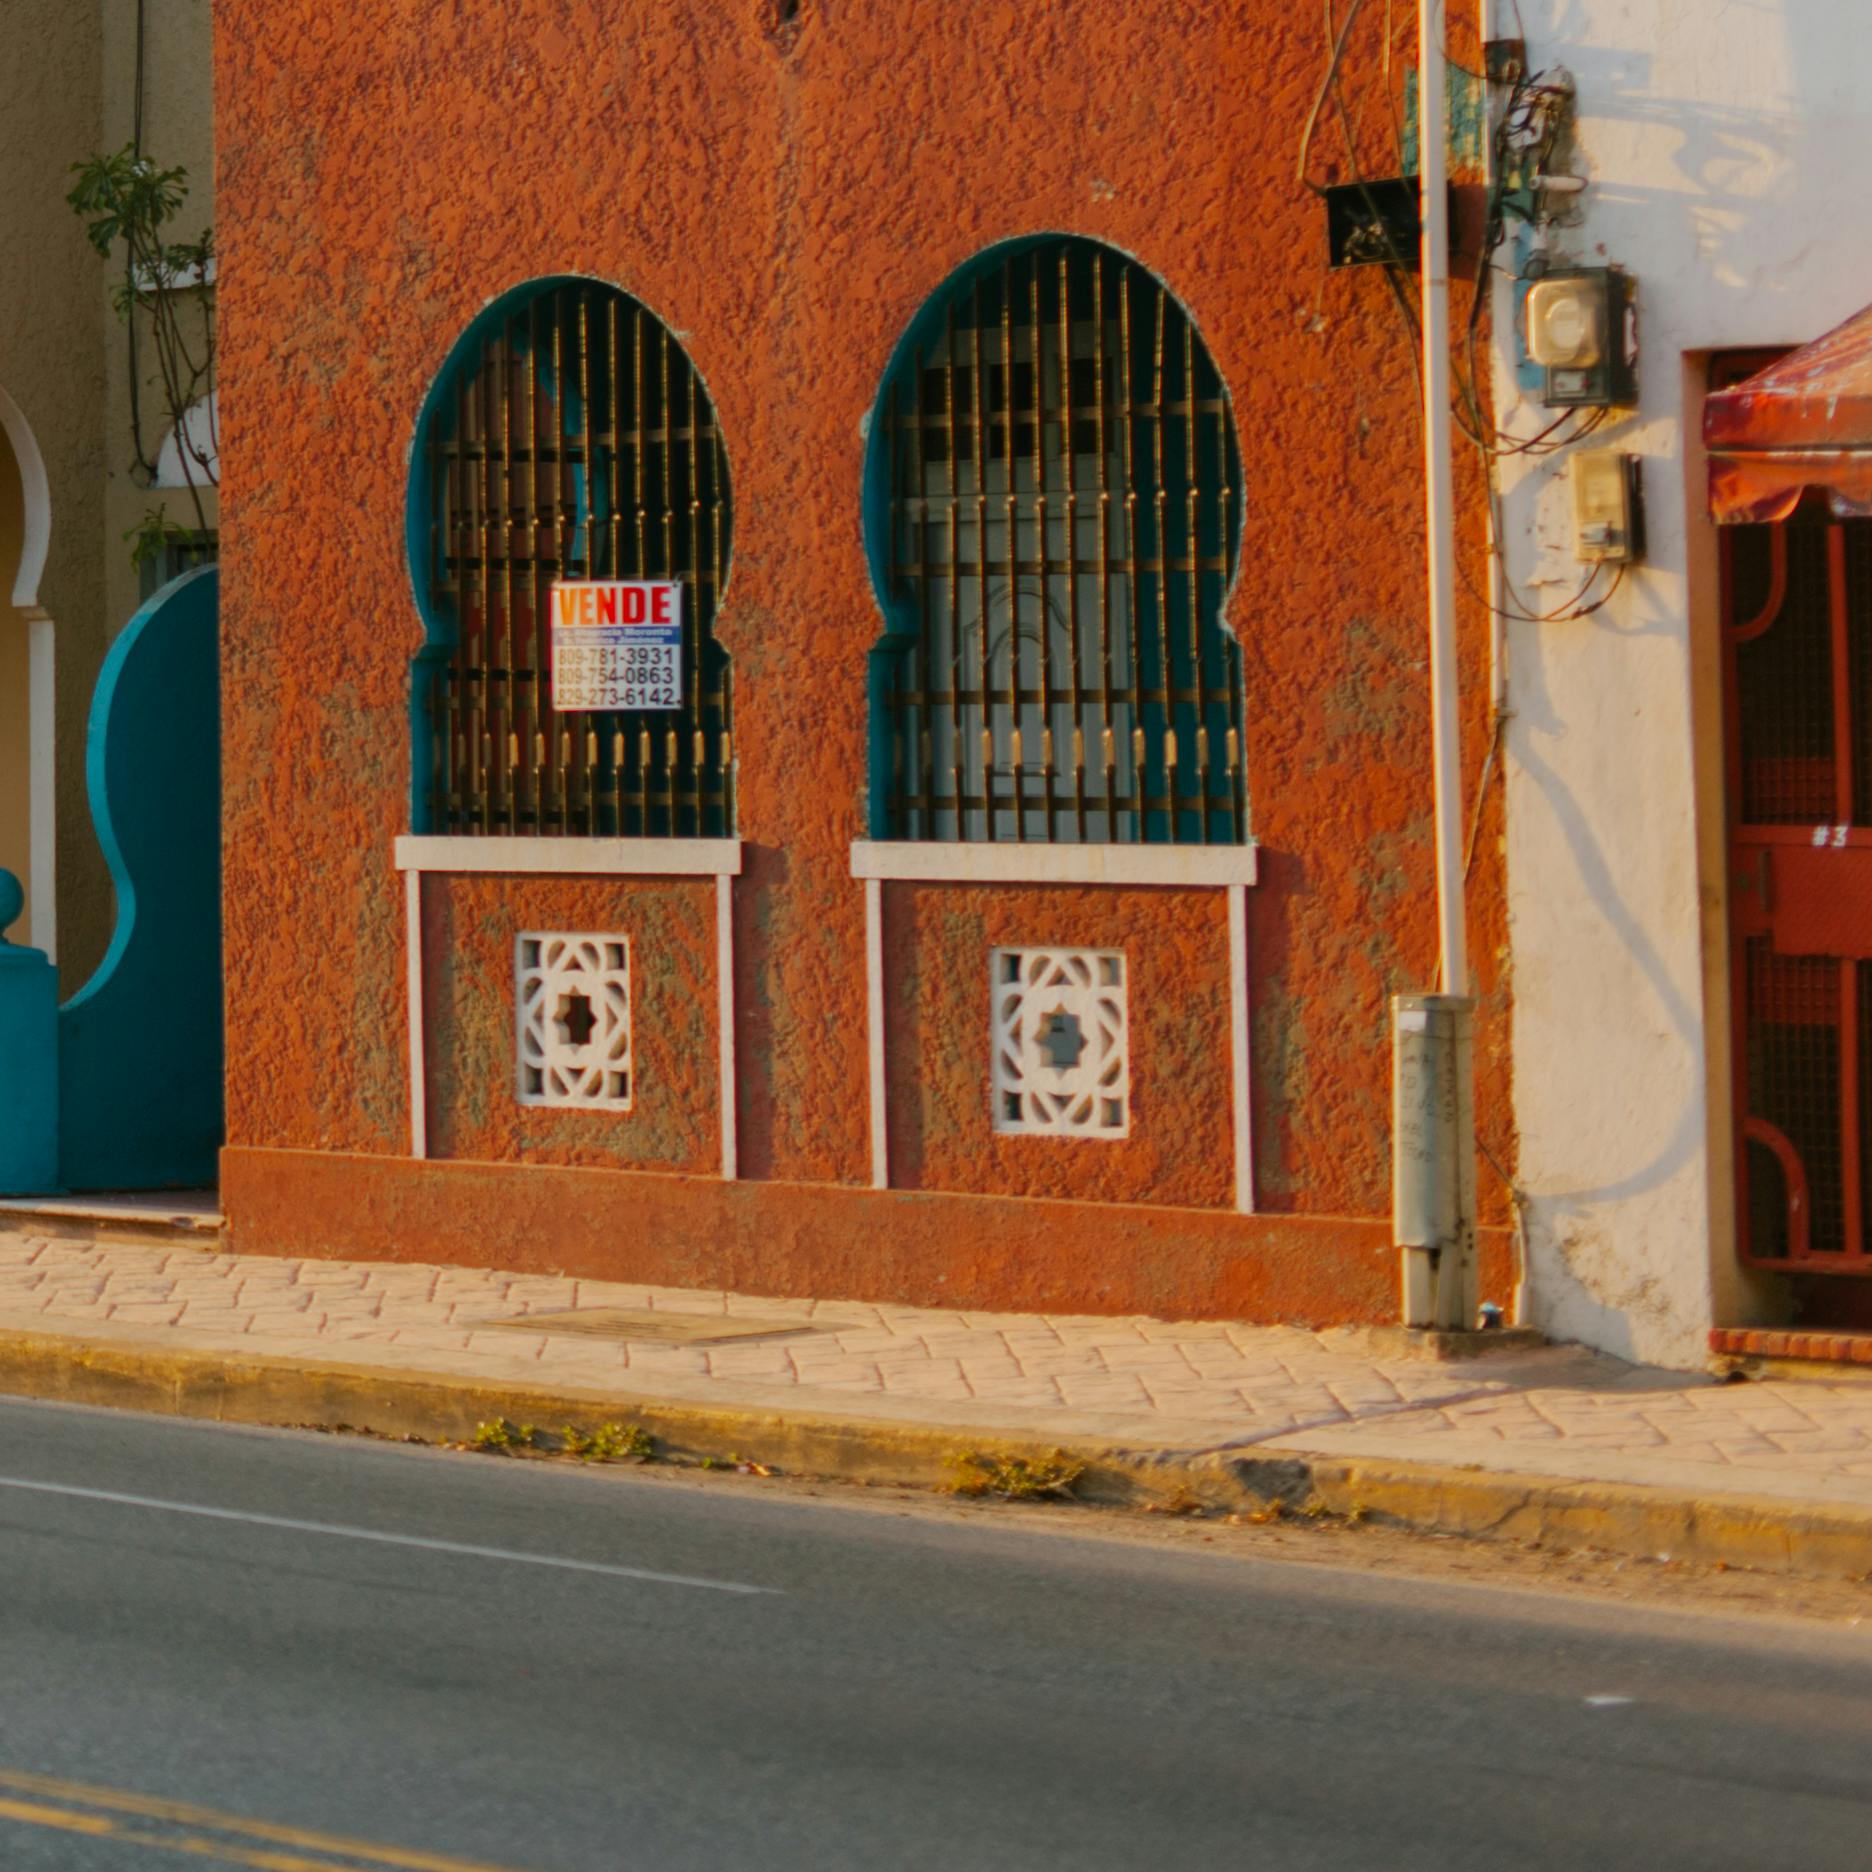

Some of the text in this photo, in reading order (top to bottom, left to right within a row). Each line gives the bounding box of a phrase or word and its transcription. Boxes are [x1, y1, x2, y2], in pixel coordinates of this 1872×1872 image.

[559, 587, 671, 625] VENDE
[559, 647, 673, 665] 809-781-3931
[558, 667, 673, 685] 809-754-0863
